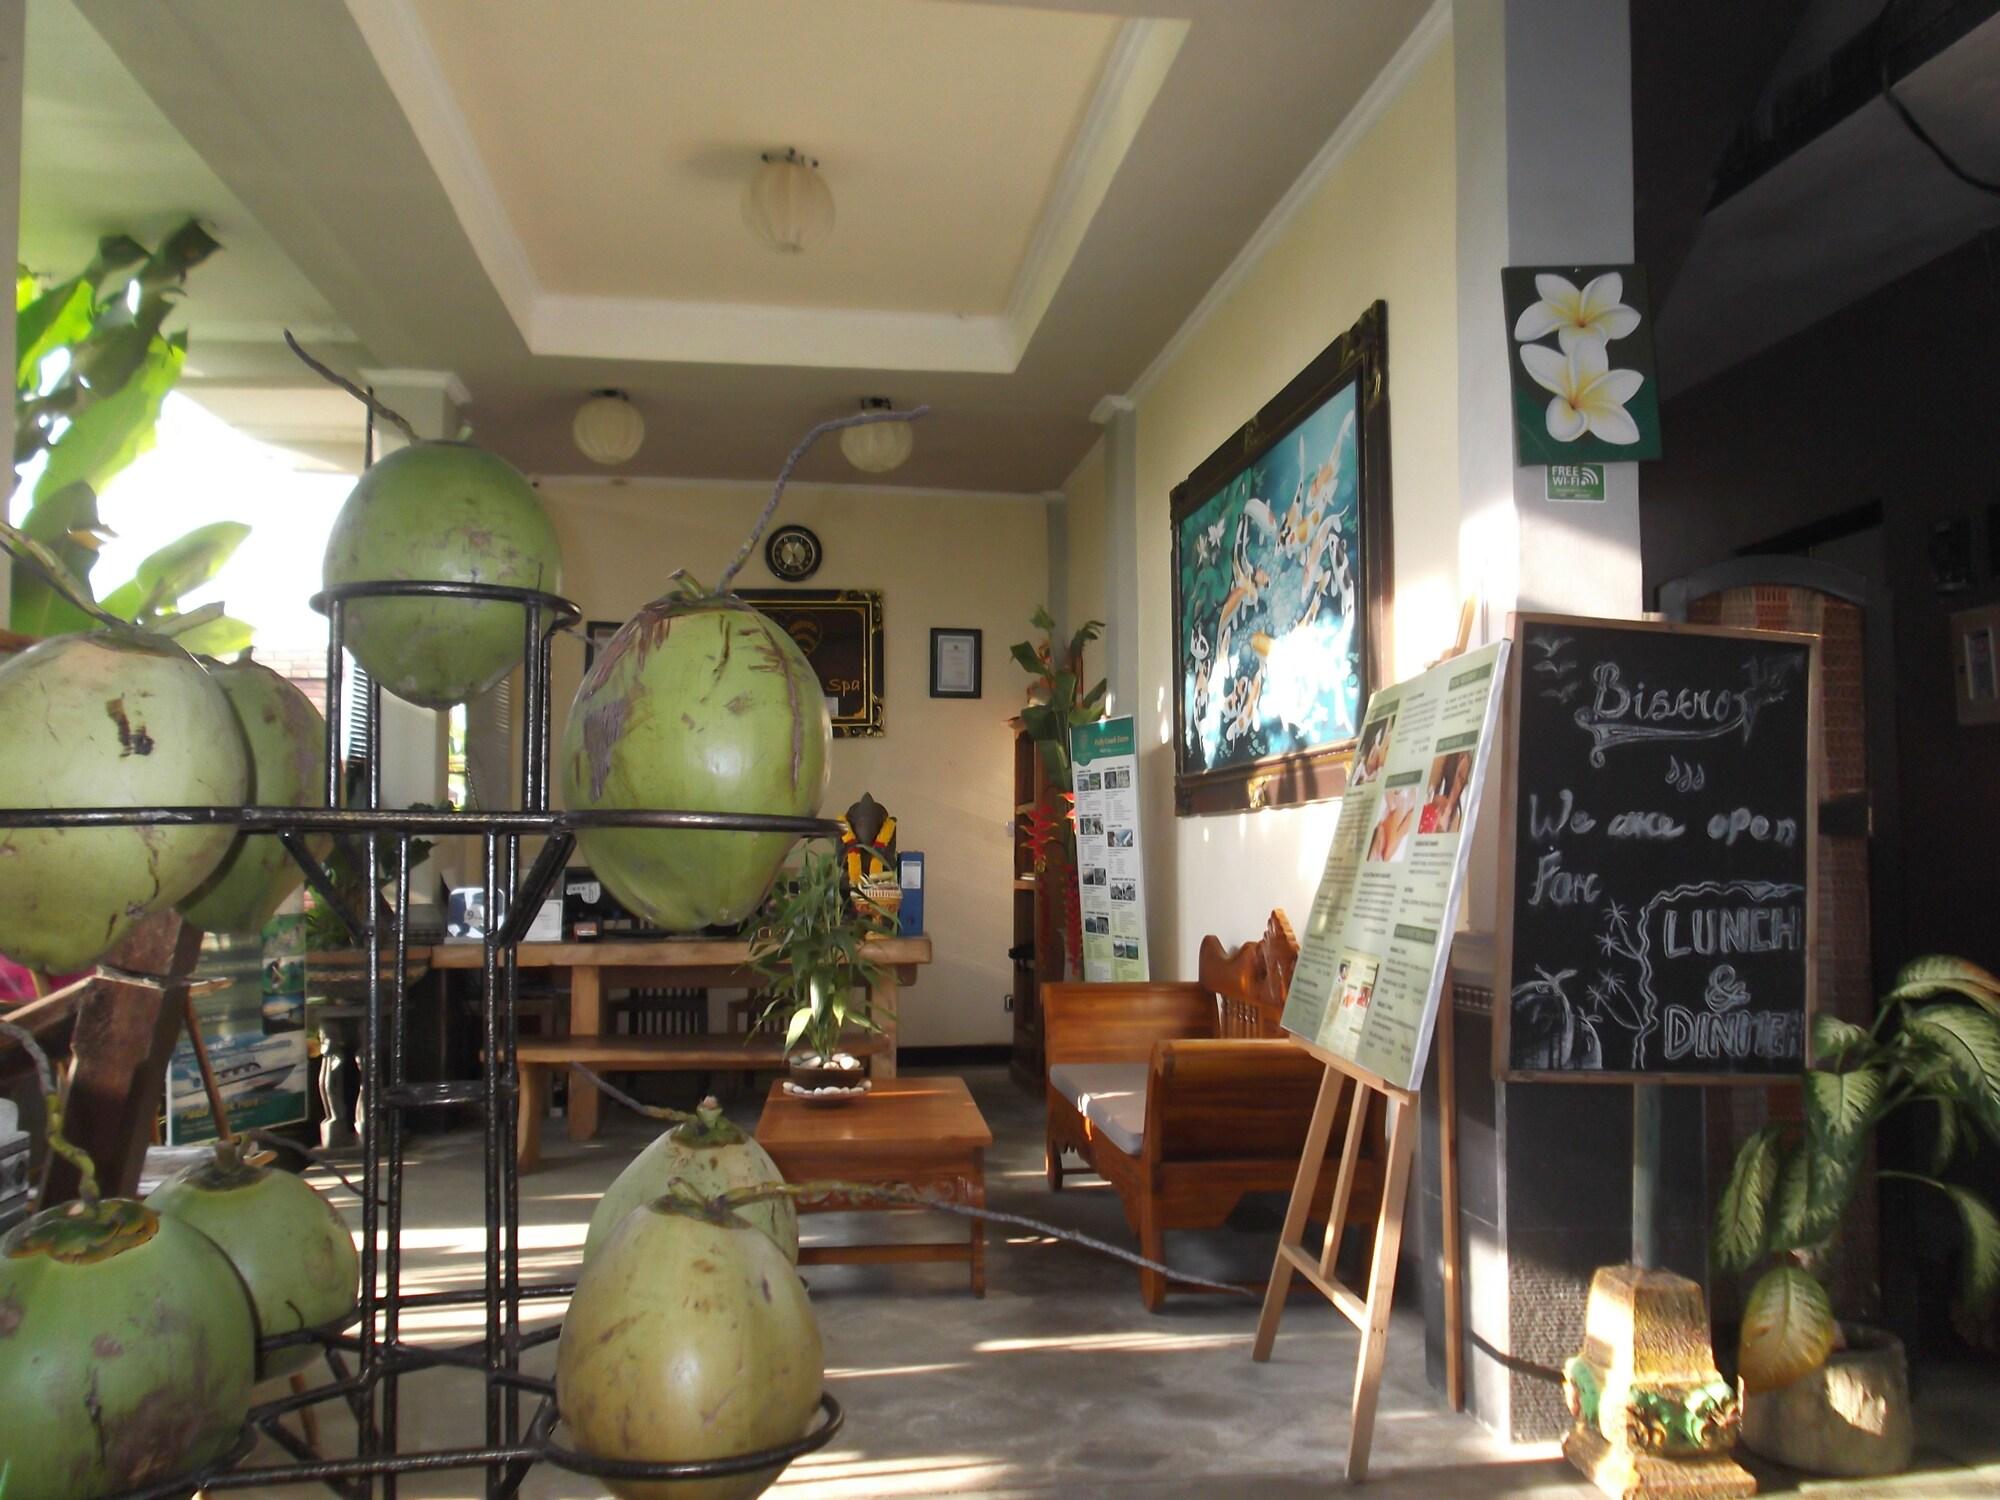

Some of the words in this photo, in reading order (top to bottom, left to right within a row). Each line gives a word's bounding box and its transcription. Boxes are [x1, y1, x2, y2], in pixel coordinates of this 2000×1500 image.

[1551, 465, 1580, 477] FREE
[827, 679, 861, 697] Spa
[1593, 662, 1735, 722] Bistro
[1528, 788, 1597, 841] We
[1607, 811, 1686, 839] are
[1707, 808, 1797, 846] open
[1663, 906, 1802, 959] LUNCH
[1704, 964, 1751, 1013] &
